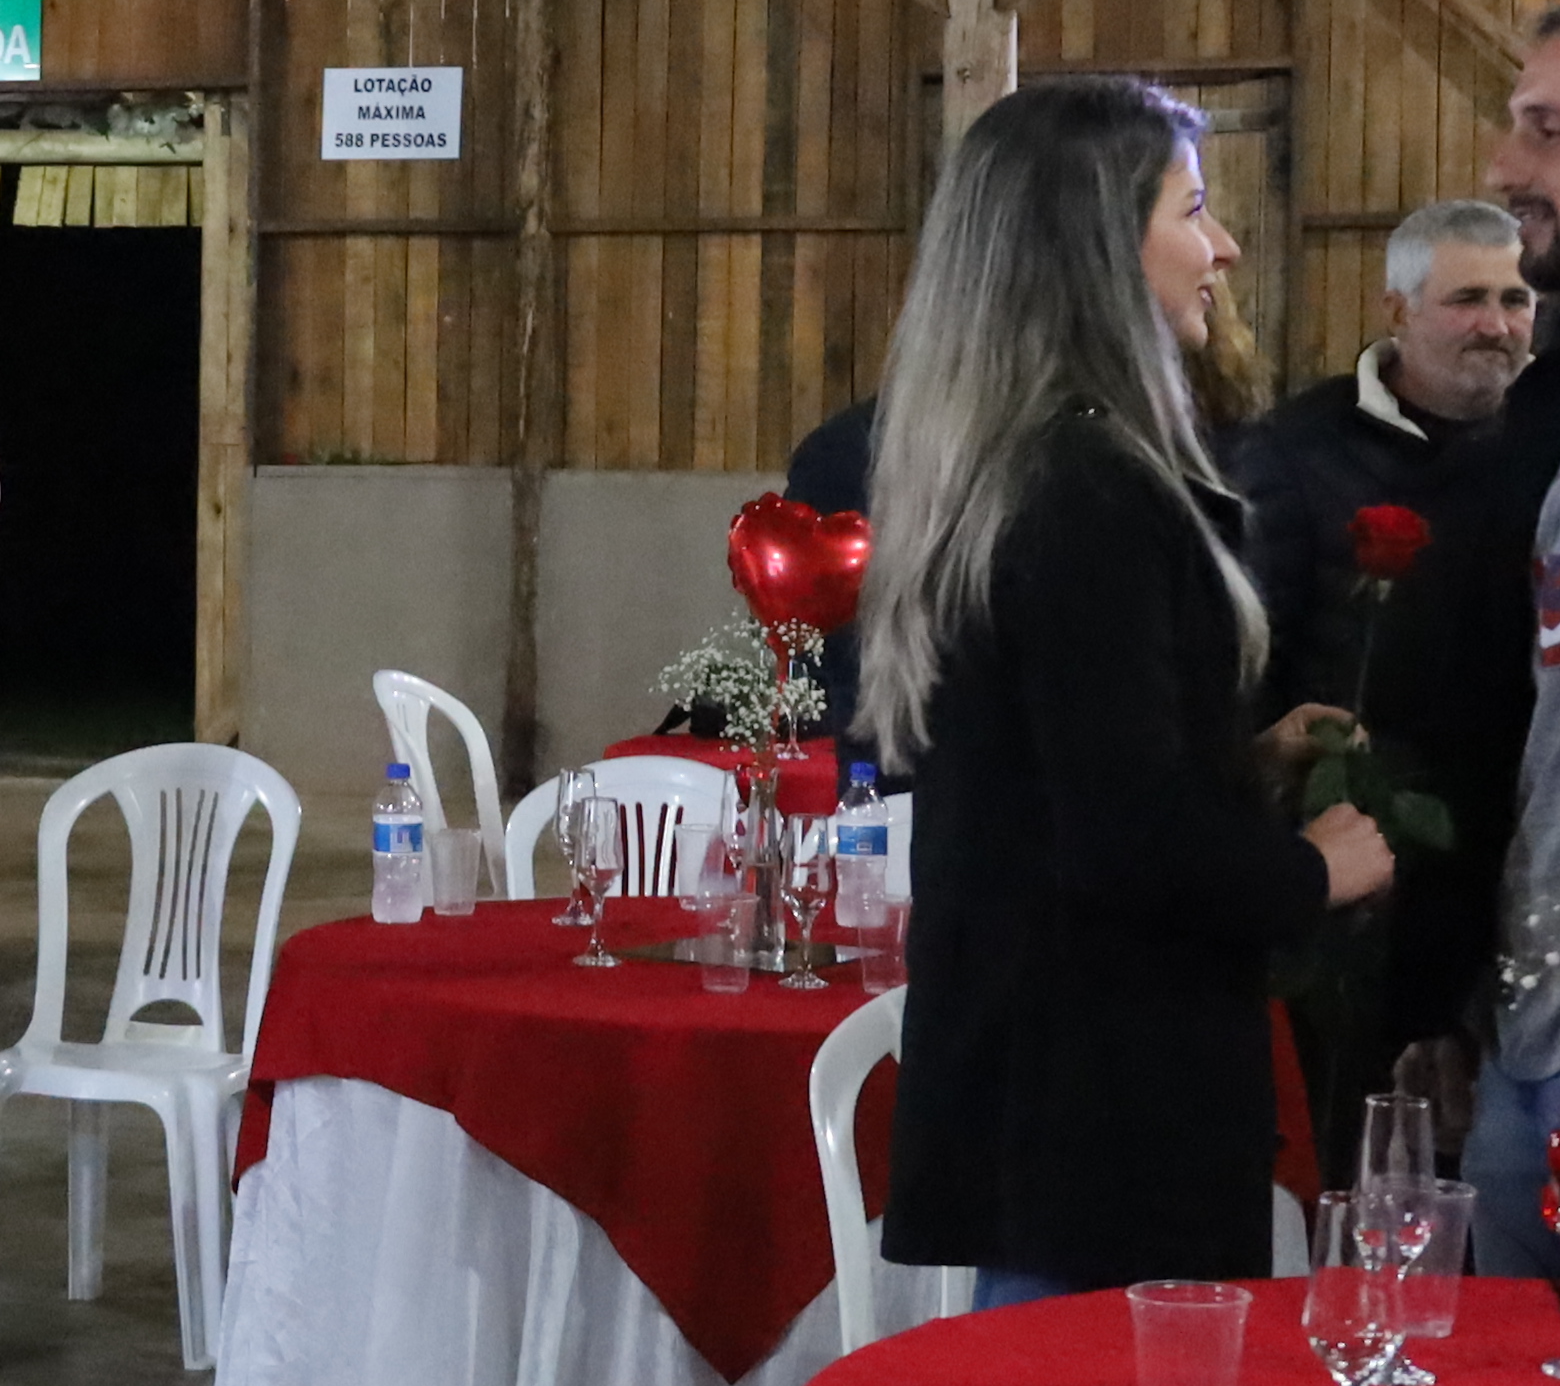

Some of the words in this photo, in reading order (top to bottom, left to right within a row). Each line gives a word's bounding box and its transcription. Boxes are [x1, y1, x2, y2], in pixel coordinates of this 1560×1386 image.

[354, 75, 432, 96] LOTAÇÃO
[358, 102, 426, 120] MÁXIMA
[335, 133, 364, 147] 588
[370, 133, 447, 147] PESSOAS
